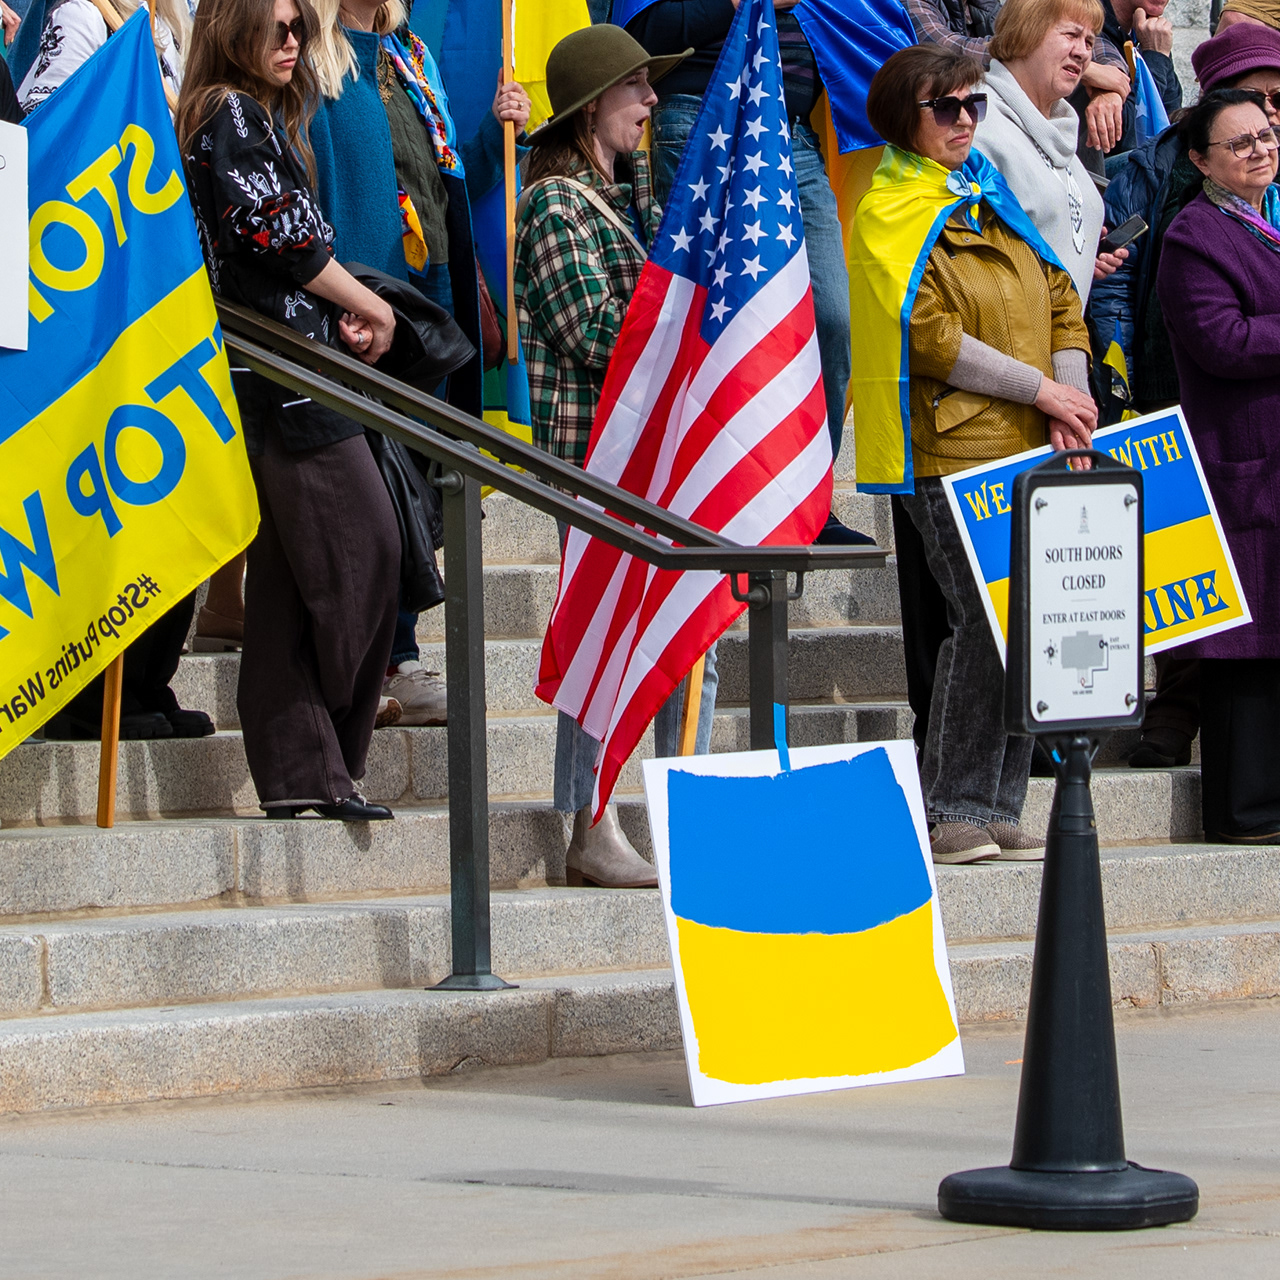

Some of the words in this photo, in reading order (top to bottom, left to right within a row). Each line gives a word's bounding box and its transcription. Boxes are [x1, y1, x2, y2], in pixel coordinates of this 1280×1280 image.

[964, 480, 1012, 522] WE
[1044, 547, 1082, 564] SOUTH
[1085, 544, 1124, 562] DOORS
[1061, 574, 1106, 592] CLOSED
[1042, 613, 1067, 625] ENTER
[1067, 612, 1079, 623] AT
[1080, 611, 1099, 623] EAST
[1100, 609, 1126, 621] DOORS
